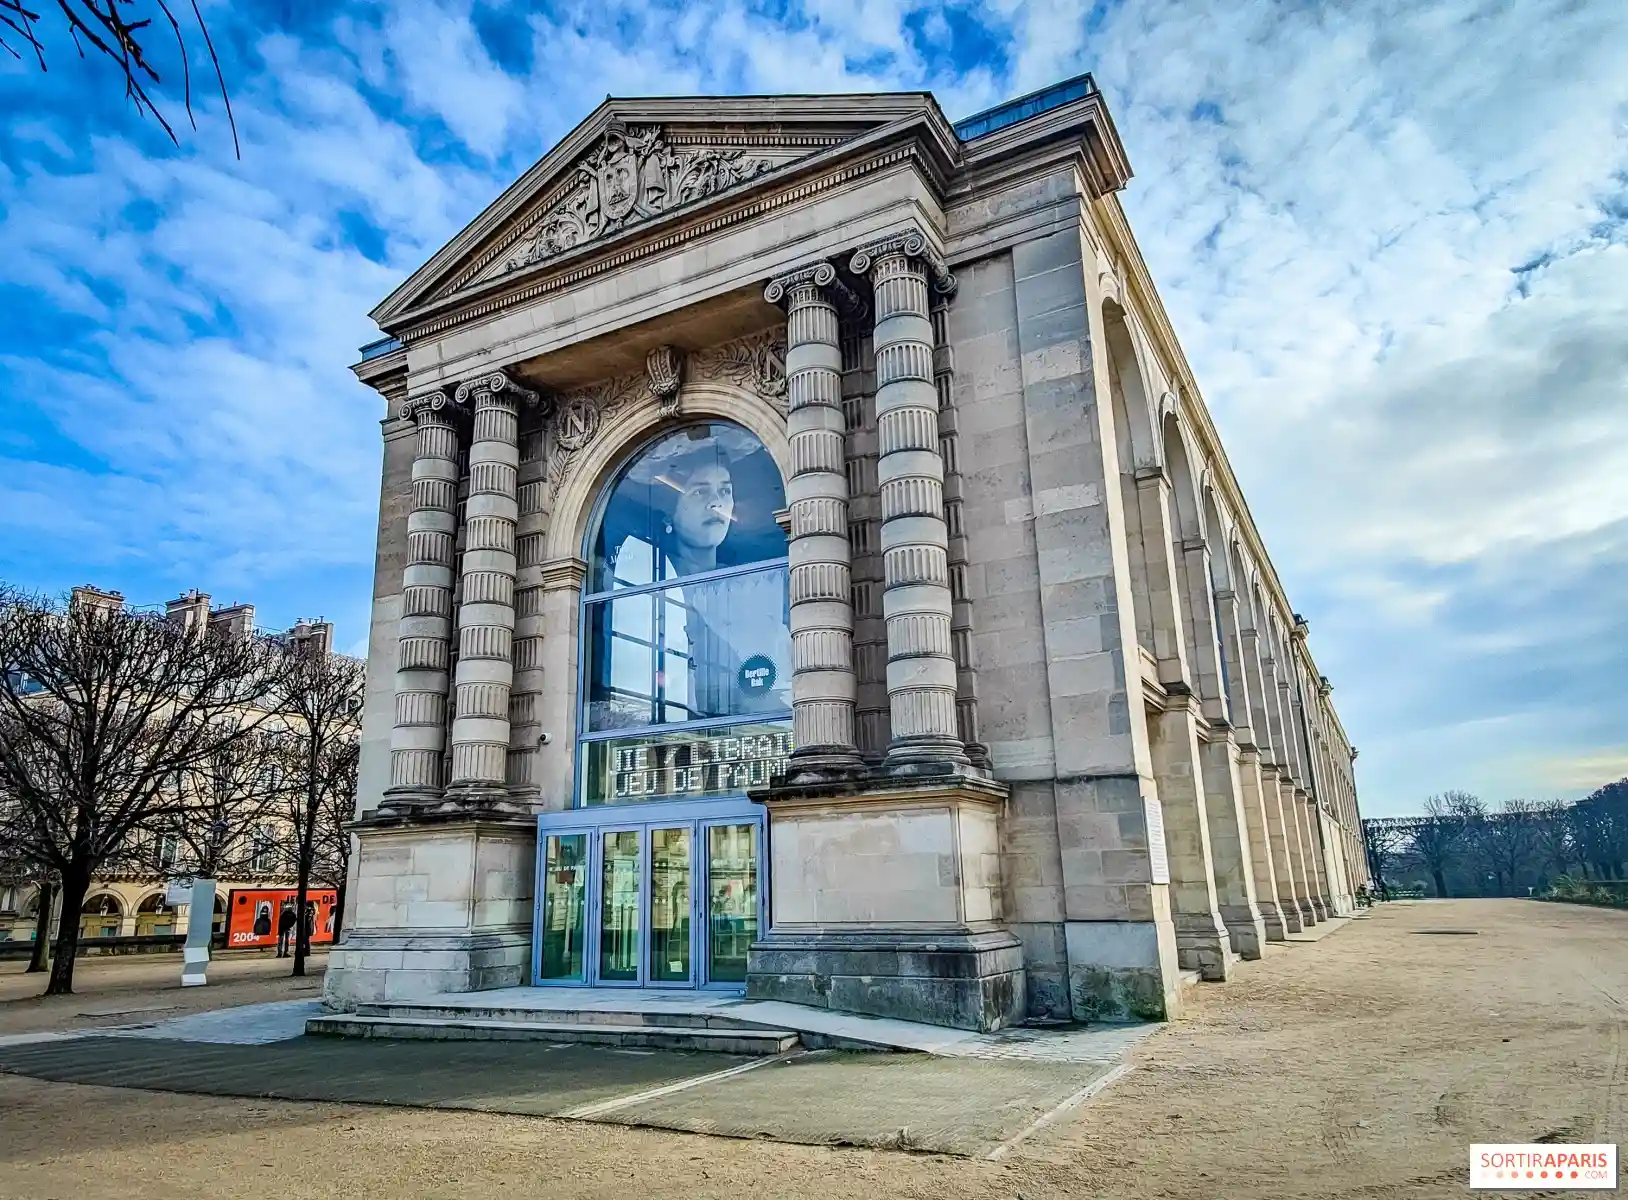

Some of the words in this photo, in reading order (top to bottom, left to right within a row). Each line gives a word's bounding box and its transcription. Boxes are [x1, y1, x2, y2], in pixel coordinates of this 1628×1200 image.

[565, 402, 585, 437] N
[616, 771, 657, 796] JEU
[673, 767, 702, 792] DE
[322, 894, 337, 905] DE
